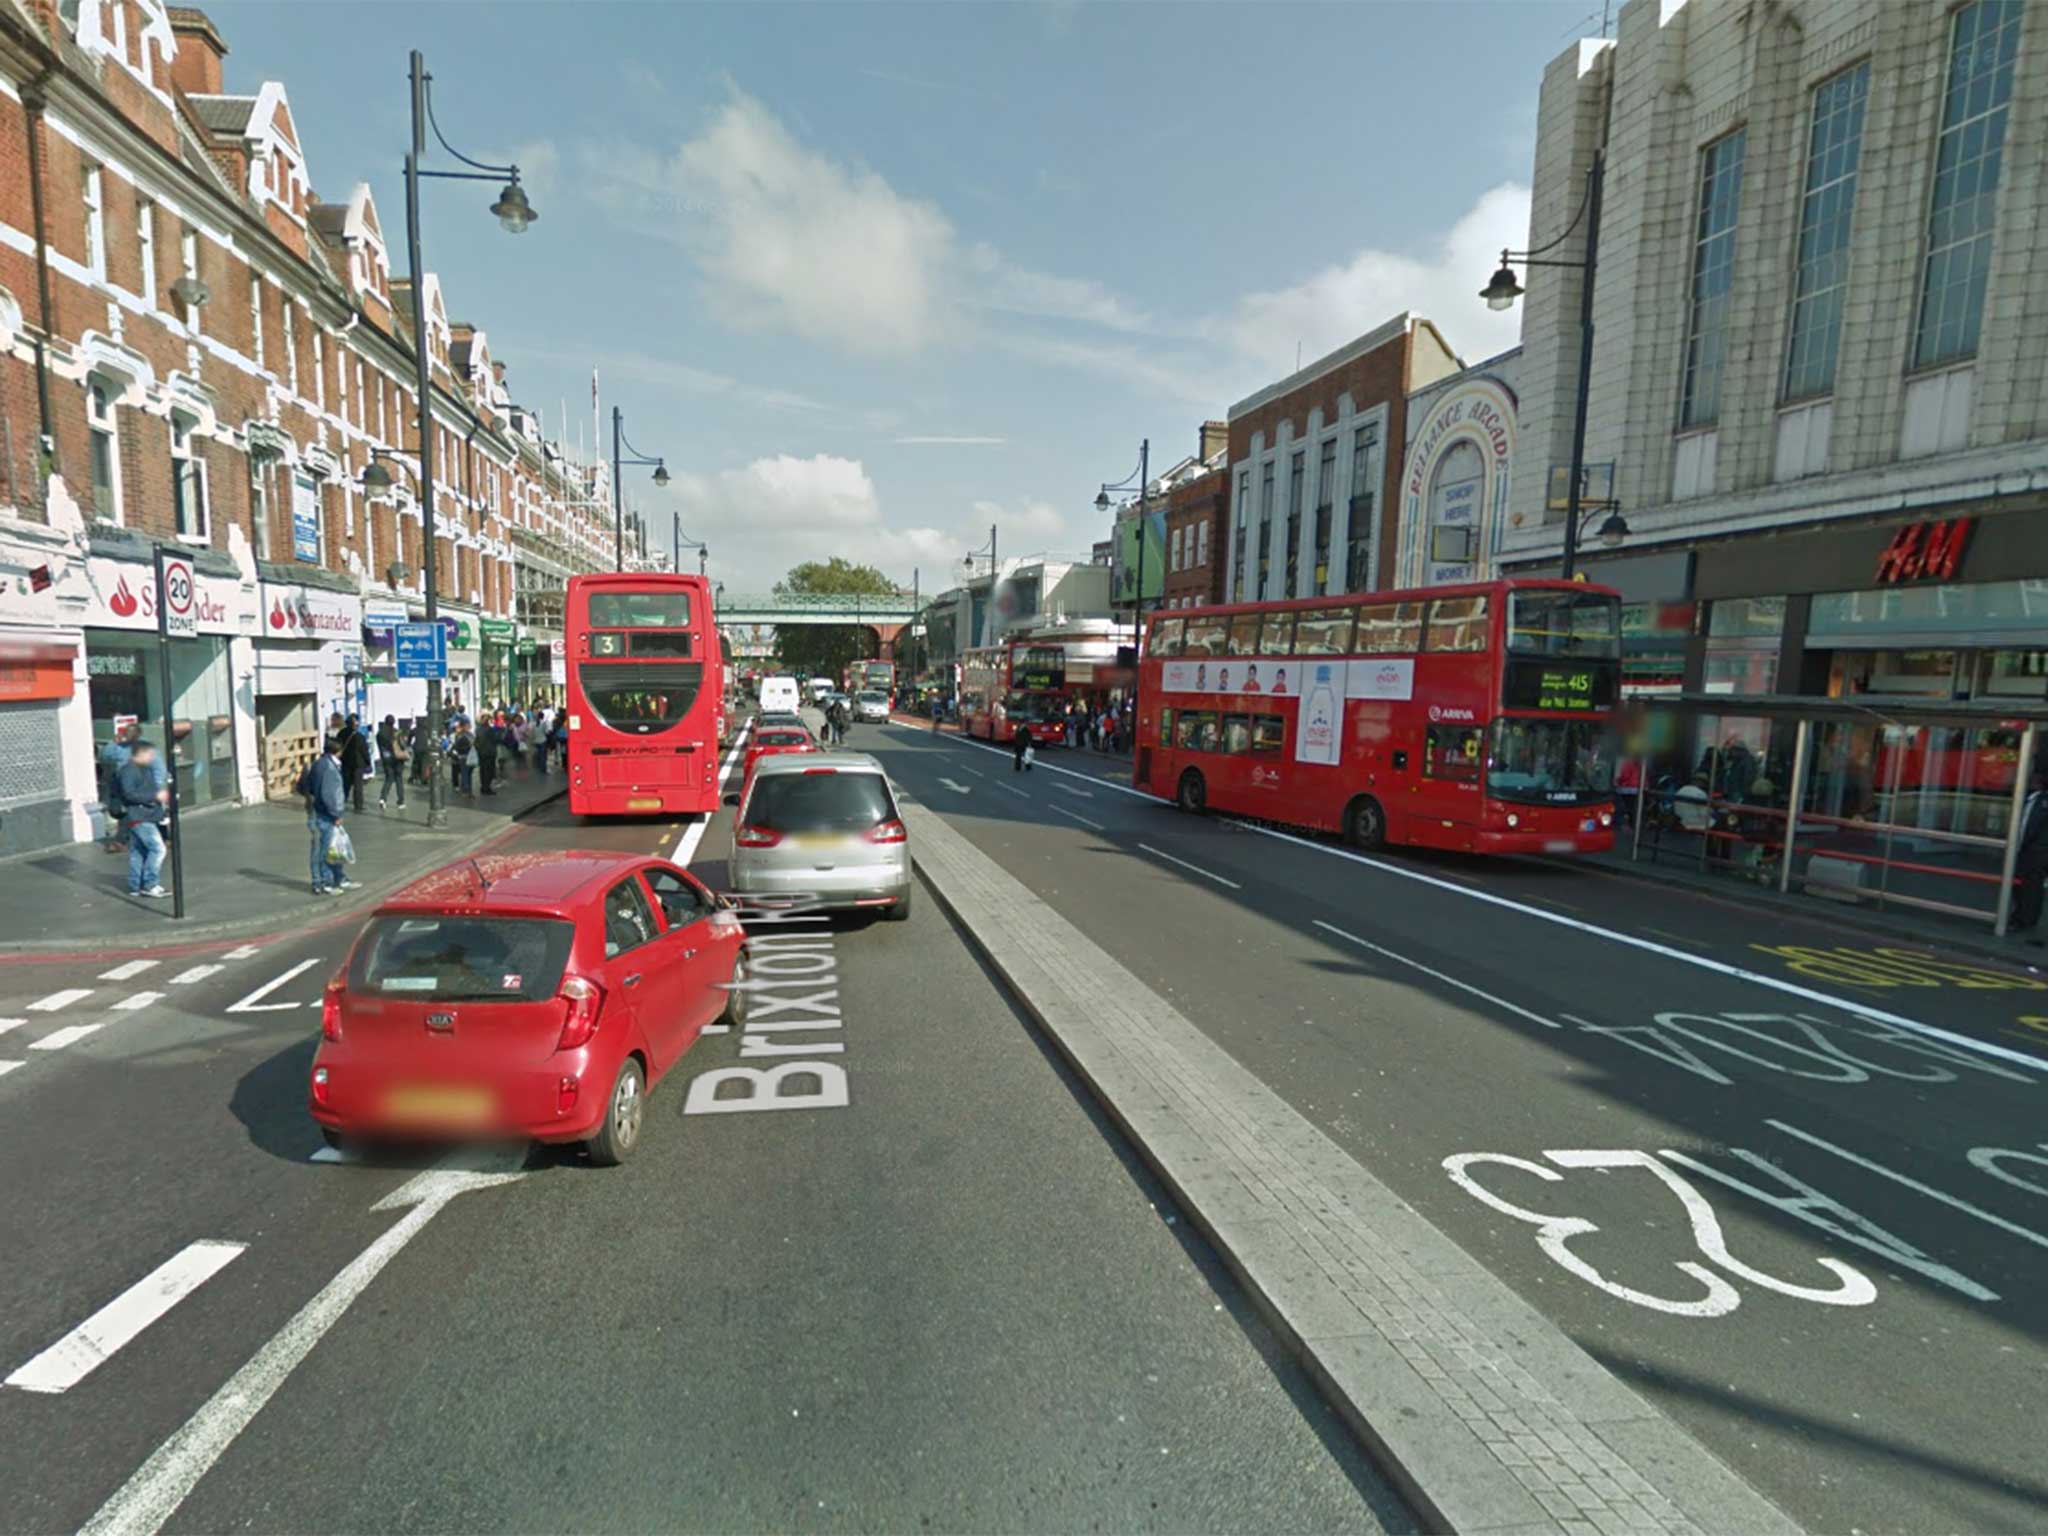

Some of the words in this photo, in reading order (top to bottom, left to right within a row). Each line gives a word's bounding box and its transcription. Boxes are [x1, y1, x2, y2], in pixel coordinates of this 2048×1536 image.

[1409, 401, 1464, 497] RELIANCE
[1467, 400, 1510, 472] ARCADE
[1445, 484, 1474, 503] SHOP
[1444, 505, 1472, 521] HERE
[1874, 515, 1972, 583] H&M
[1435, 566, 1472, 582] MONEY
[170, 577, 189, 600] 20
[168, 616, 194, 631] ZONE
[298, 603, 352, 632] Santander
[601, 636, 614, 654] 3
[1568, 674, 1588, 691] 415
[1441, 709, 1475, 721] ARRIVA
[1441, 1146, 2001, 1317] A23
